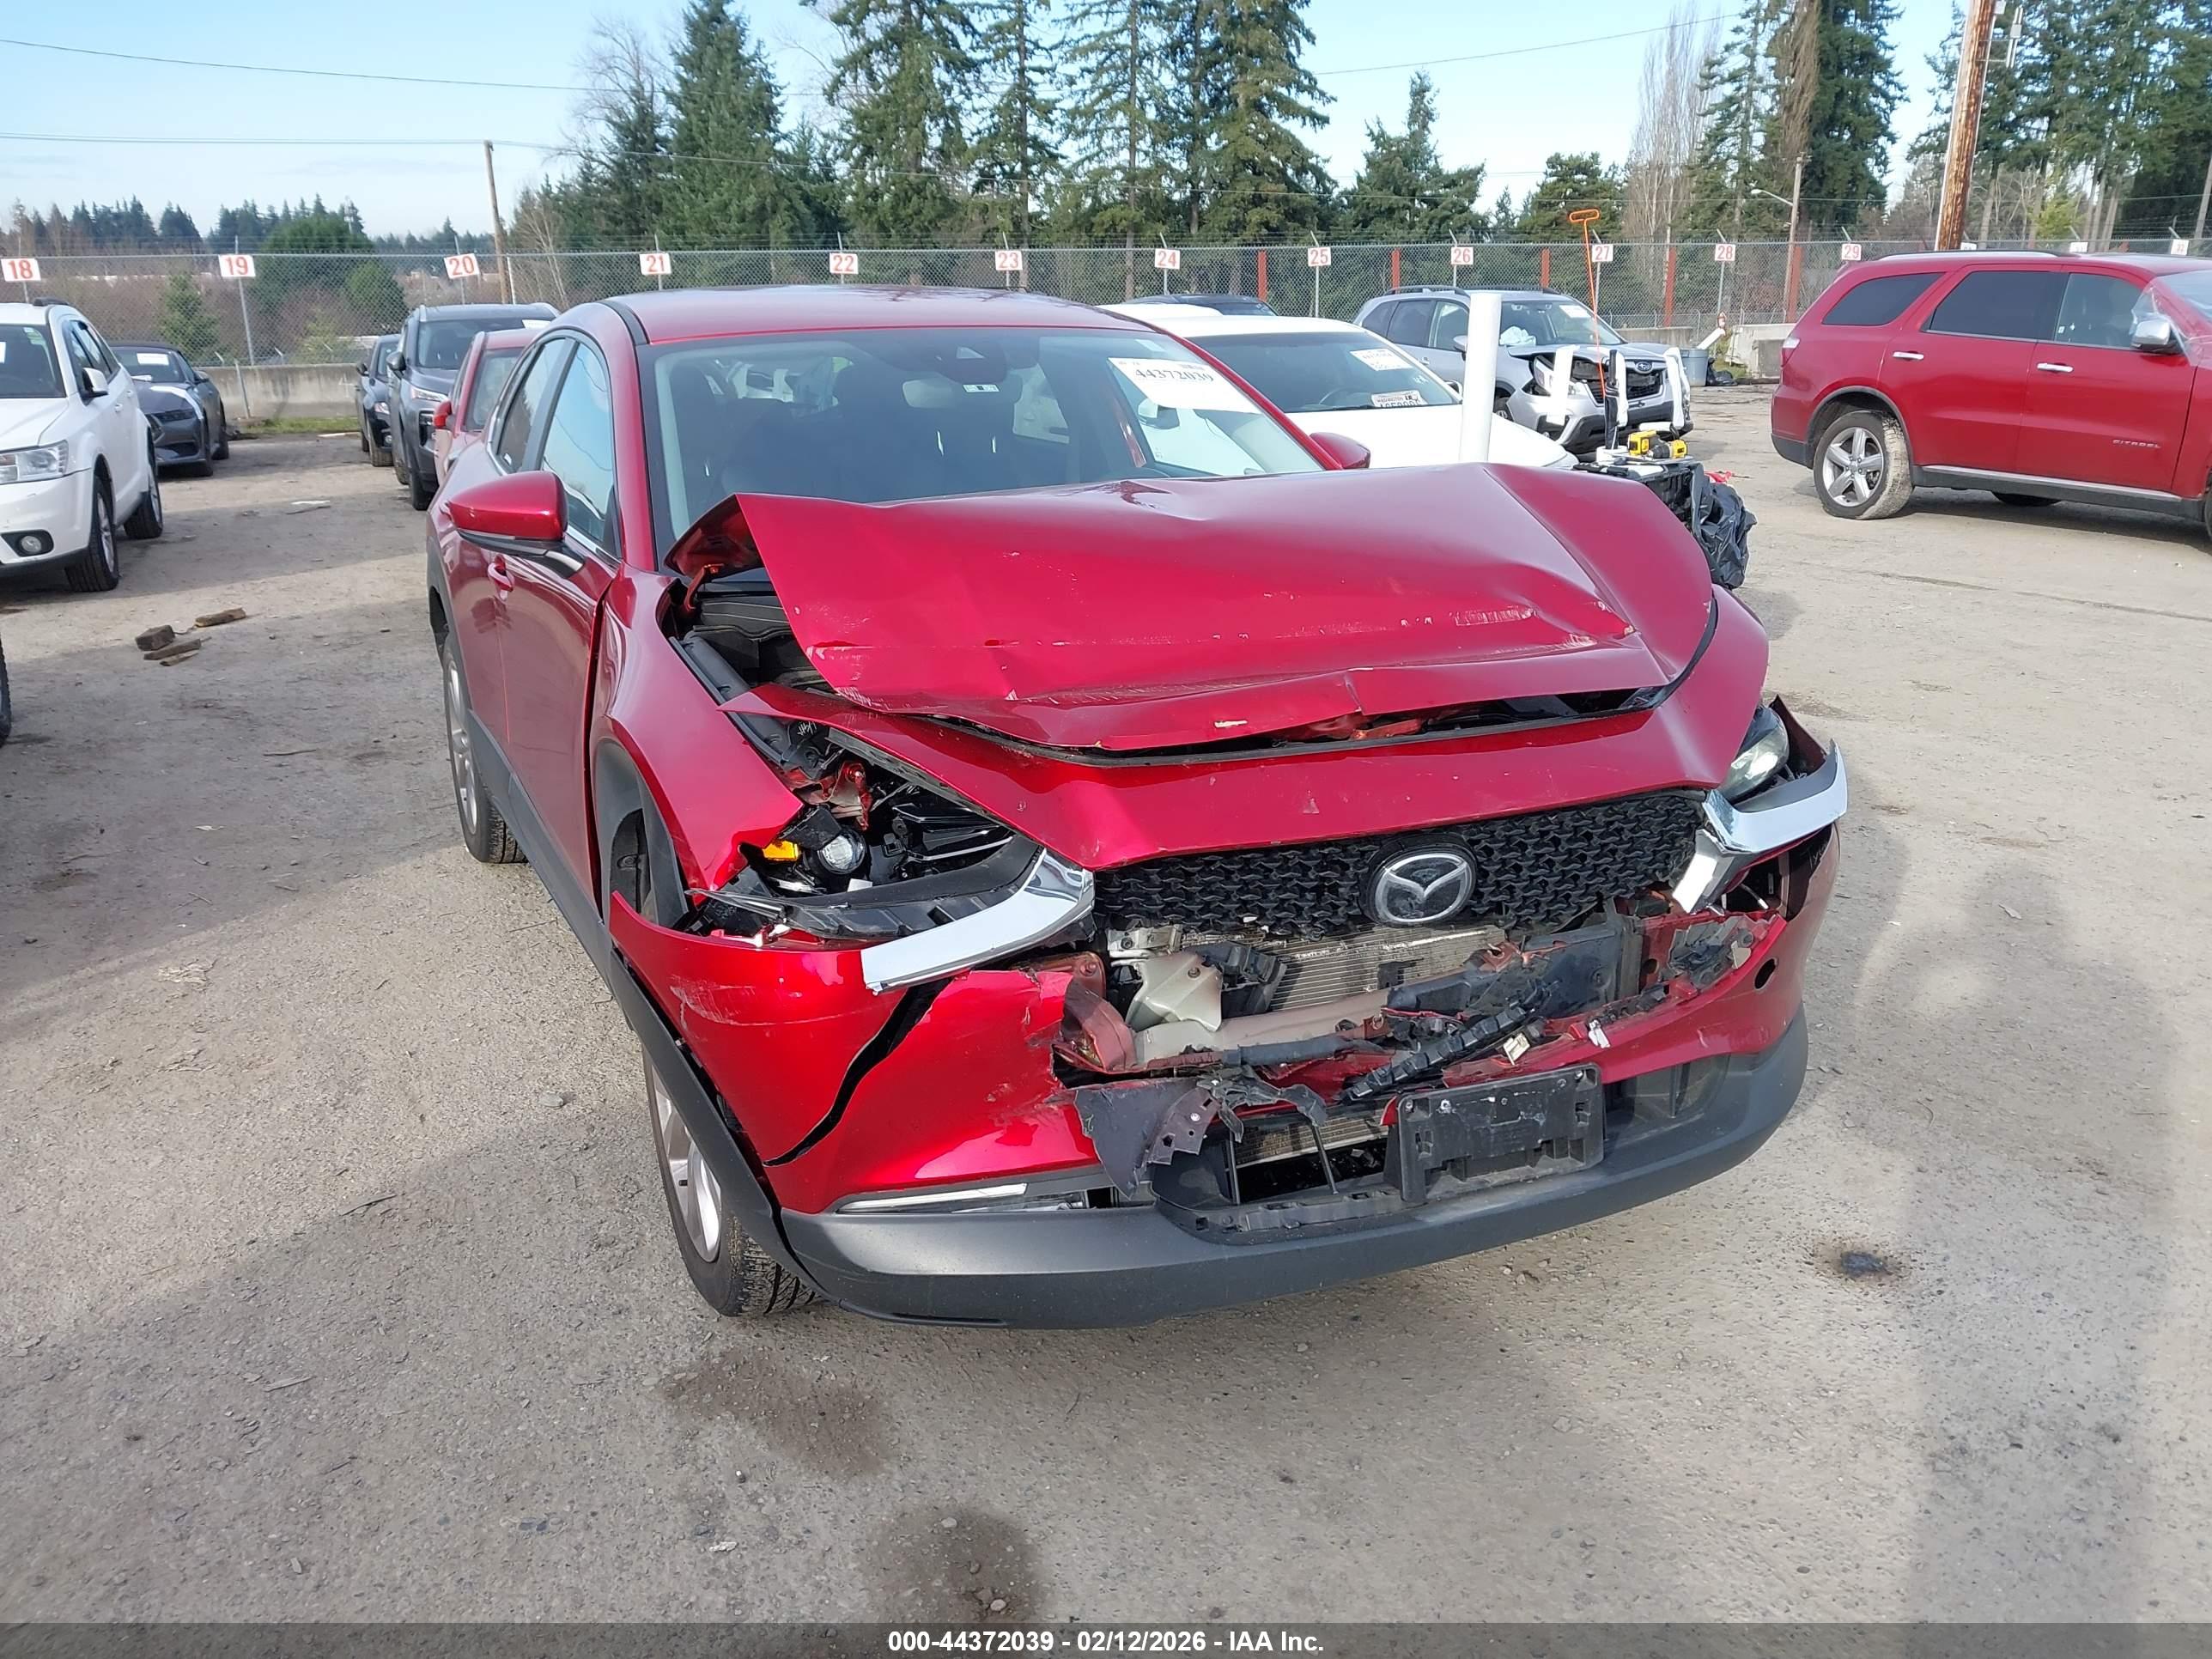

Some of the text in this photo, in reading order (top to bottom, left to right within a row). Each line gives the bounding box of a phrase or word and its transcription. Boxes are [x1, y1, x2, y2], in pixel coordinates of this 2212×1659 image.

[1158, 251, 1176, 266] 24
[1310, 249, 1328, 264] 25
[1454, 248, 1471, 263] 26
[1595, 246, 1610, 260] 27
[1717, 246, 1733, 259] 28
[1844, 246, 1859, 258] 29
[227, 257, 248, 276] 19
[449, 256, 474, 276] 20
[646, 255, 665, 272] 21
[833, 255, 854, 271] 22
[999, 252, 1018, 268] 23
[9, 259, 33, 279] 18
